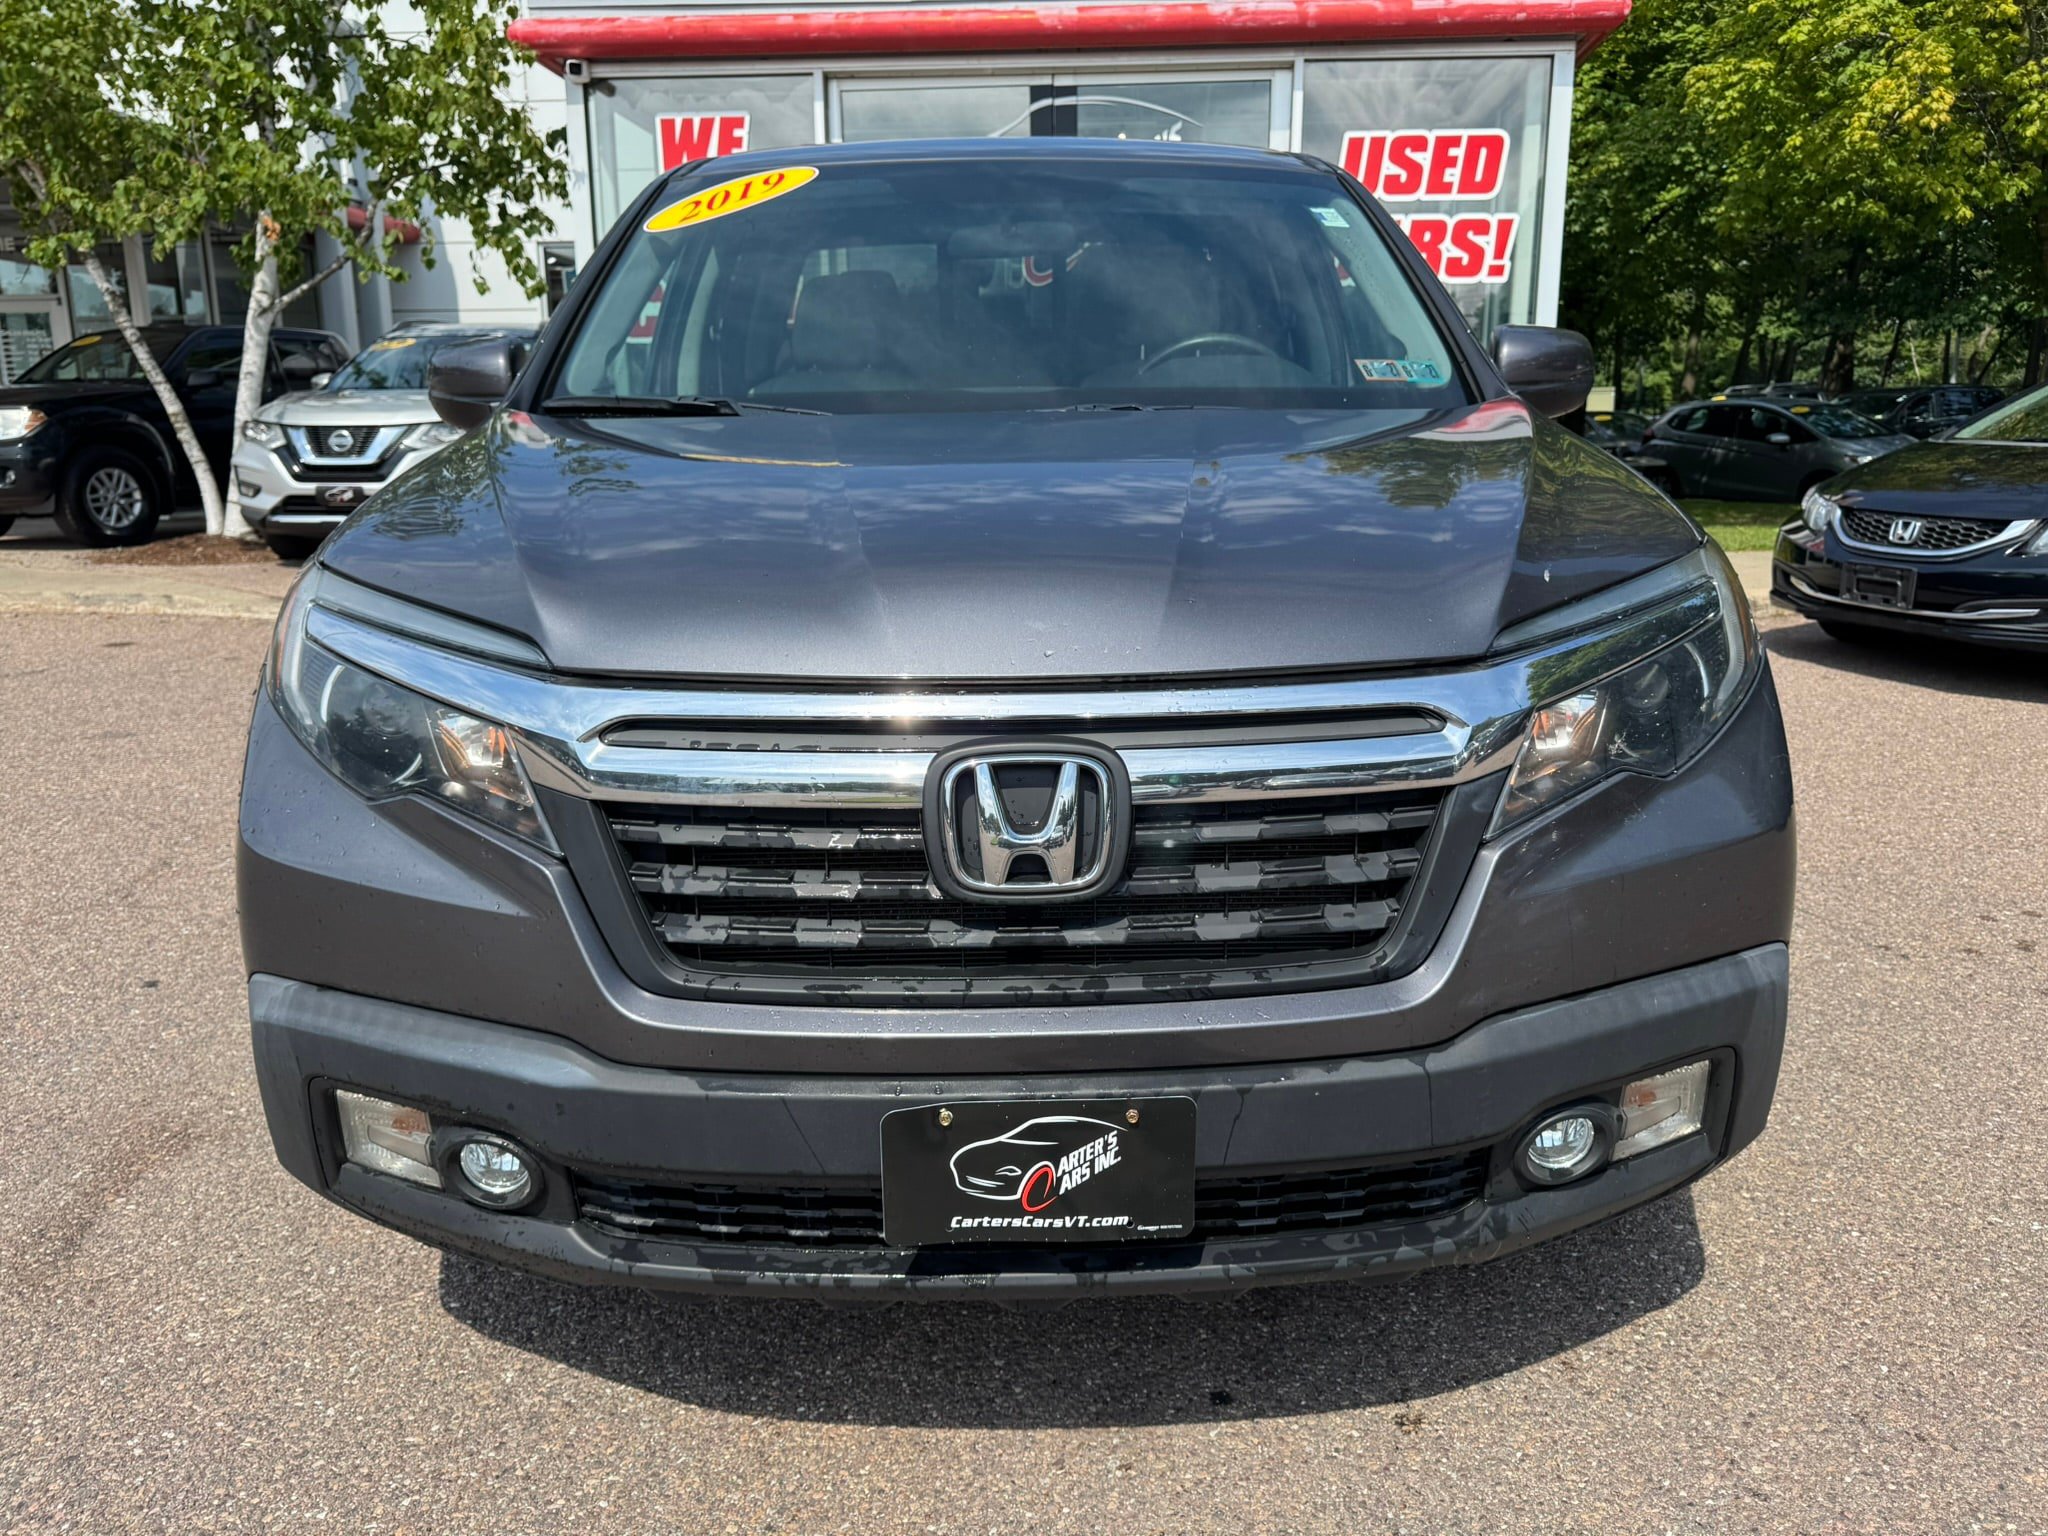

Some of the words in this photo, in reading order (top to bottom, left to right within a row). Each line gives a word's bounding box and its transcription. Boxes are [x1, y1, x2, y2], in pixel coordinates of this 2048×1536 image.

[658, 114, 748, 173] WE
[1340, 131, 1508, 199] USED
[678, 172, 786, 224] 2019
[1393, 216, 1517, 281] RS!
[950, 1215, 1129, 1228] CartersCarsVT.com
